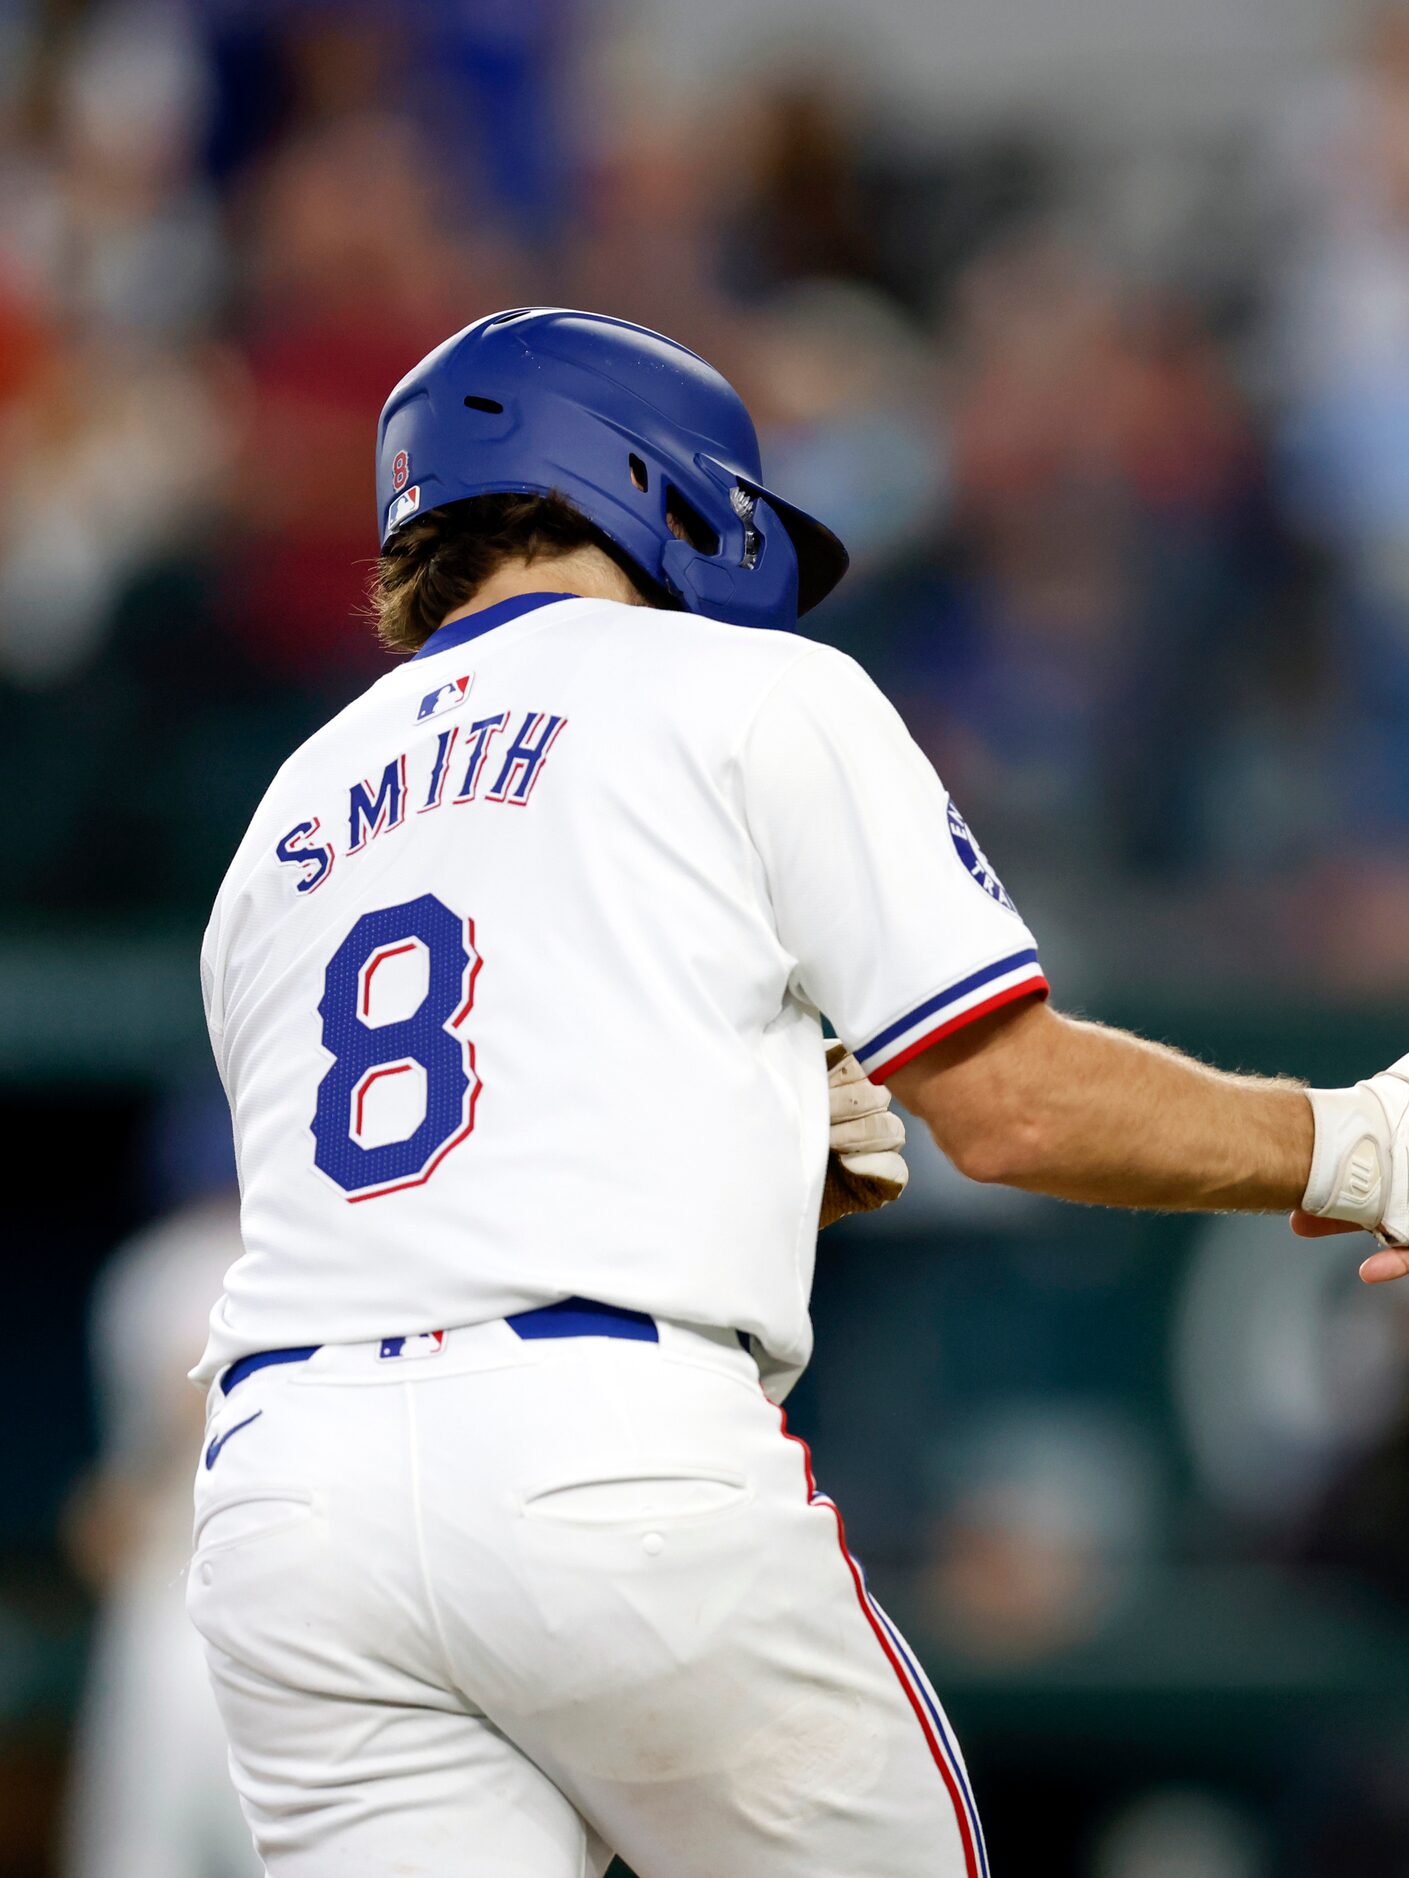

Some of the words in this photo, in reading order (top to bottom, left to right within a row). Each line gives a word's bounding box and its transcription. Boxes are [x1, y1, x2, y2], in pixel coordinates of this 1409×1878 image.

[391, 449, 410, 493] 8
[274, 709, 569, 896] SMITH
[308, 891, 485, 1207] 8
